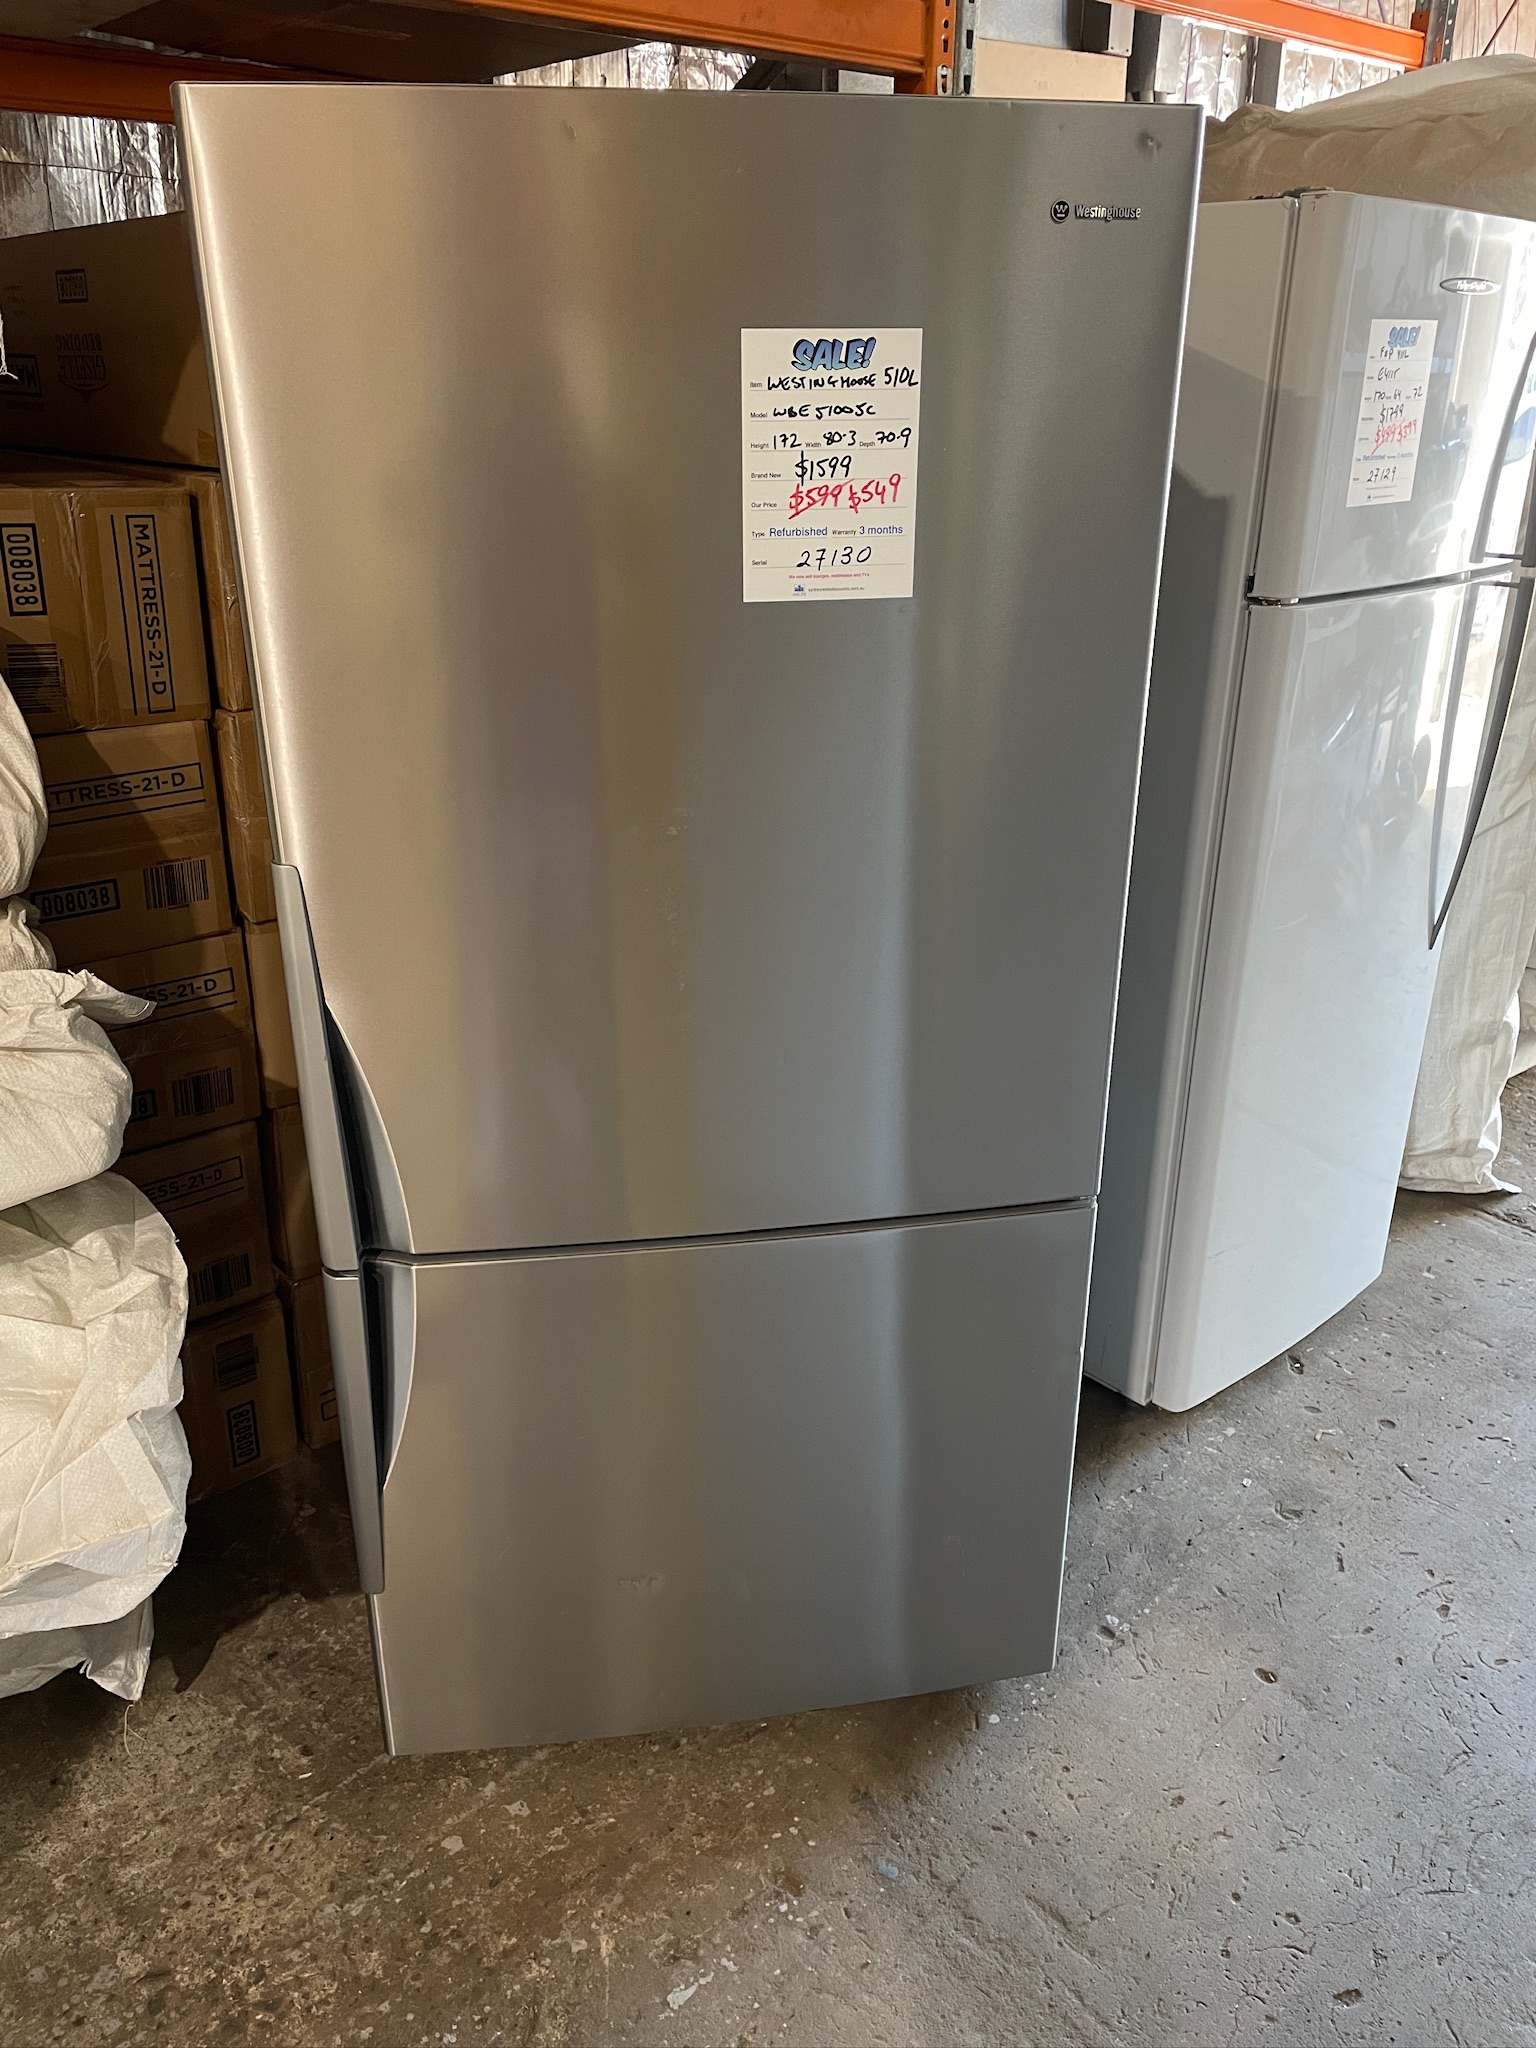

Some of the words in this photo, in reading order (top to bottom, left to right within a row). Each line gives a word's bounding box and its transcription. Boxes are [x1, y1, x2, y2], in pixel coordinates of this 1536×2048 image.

[1075, 204, 1141, 221] Westinghouse
[57, 354, 107, 381] GISELLE
[791, 337, 877, 371] SALE!
[750, 442, 769, 450] Height
[773, 433, 802, 450] 172
[794, 451, 852, 486] $1599
[1366, 466, 1397, 483] 27129
[848, 473, 901, 513] $549
[769, 527, 828, 537] Refurbished
[859, 526, 866, 535] 3
[867, 526, 904, 535] months
[6, 533, 39, 606] 008038
[796, 546, 872, 571] 27130
[133, 524, 167, 696] MATTRESS-21-D
[42, 886, 110, 917] 008038
